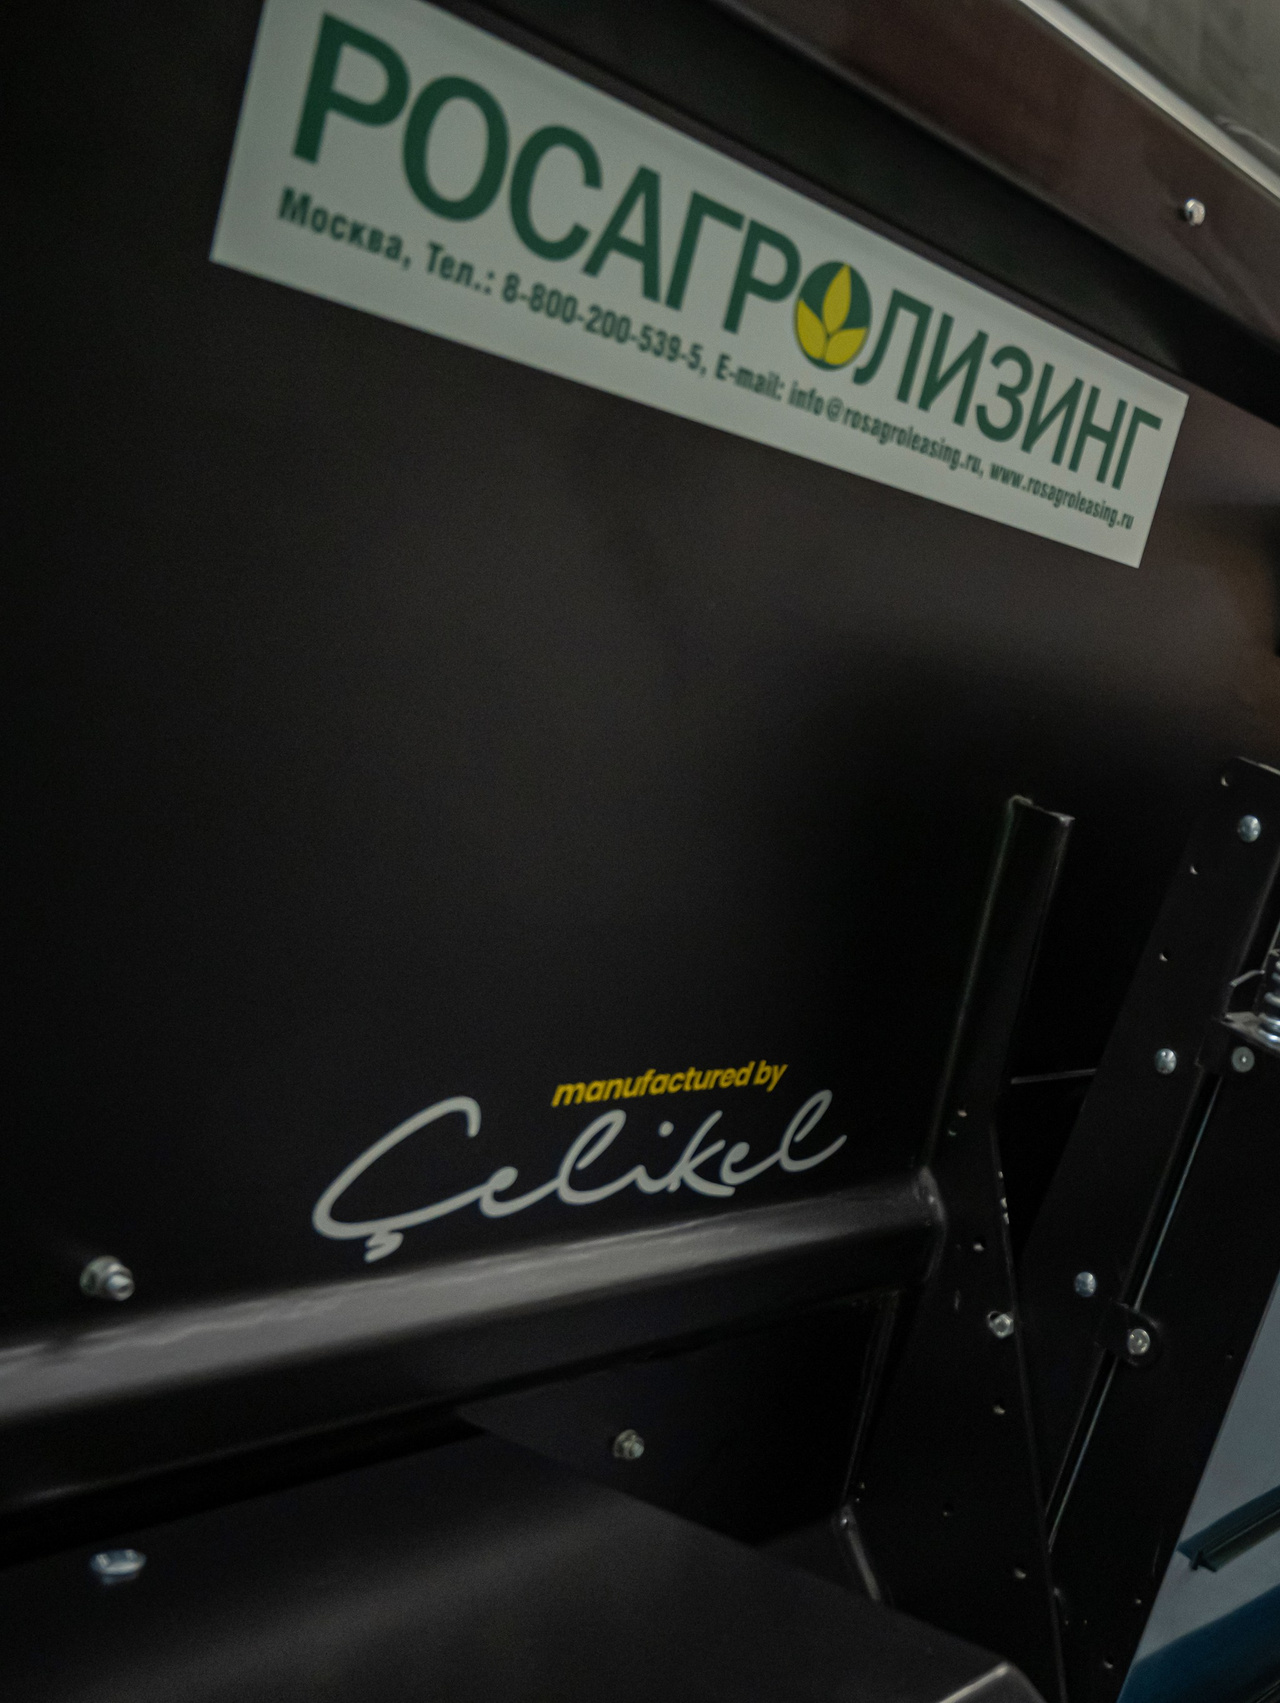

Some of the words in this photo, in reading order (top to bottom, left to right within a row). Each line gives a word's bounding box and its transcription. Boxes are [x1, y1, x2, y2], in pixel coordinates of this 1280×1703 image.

[277, 186, 413, 271] Москва,
[426, 240, 497, 297] Тел.:
[501, 271, 709, 378] 8-800-200-539-5,
[715, 353, 787, 402] E-mail:
[989, 461, 1135, 531] www.rosagroleasing.ru
[292, 11, 1164, 490] РОСАГРОЛИЗИНГ
[312, 1089, 848, 1263] Çelikel
[551, 1061, 755, 1108] manufactured
[755, 1060, 788, 1093] by
